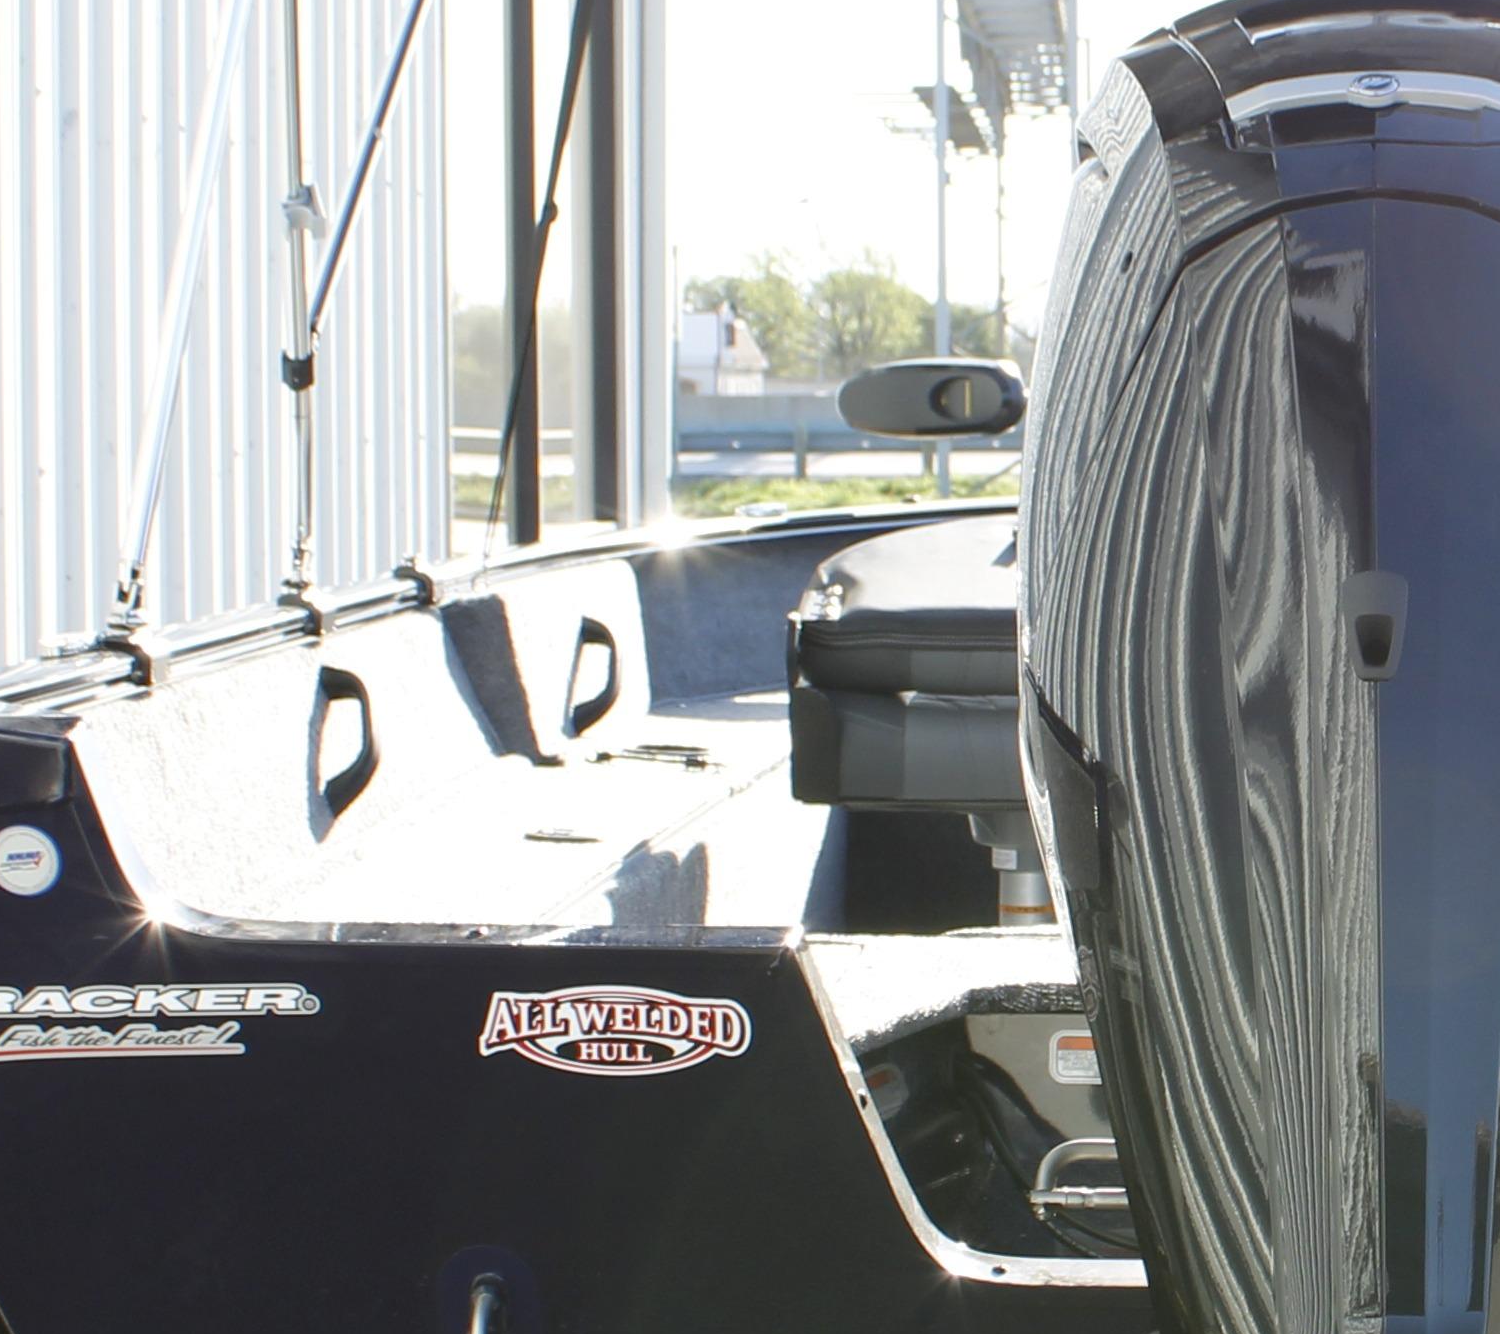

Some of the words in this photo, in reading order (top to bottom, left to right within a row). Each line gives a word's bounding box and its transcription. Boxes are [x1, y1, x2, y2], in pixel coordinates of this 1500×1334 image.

[487, 998, 569, 1045] ALL
[572, 1000, 743, 1049] WELDED
[0, 1029, 63, 1047] Fish
[66, 1029, 113, 1047] the
[577, 1041, 653, 1062] HULL
